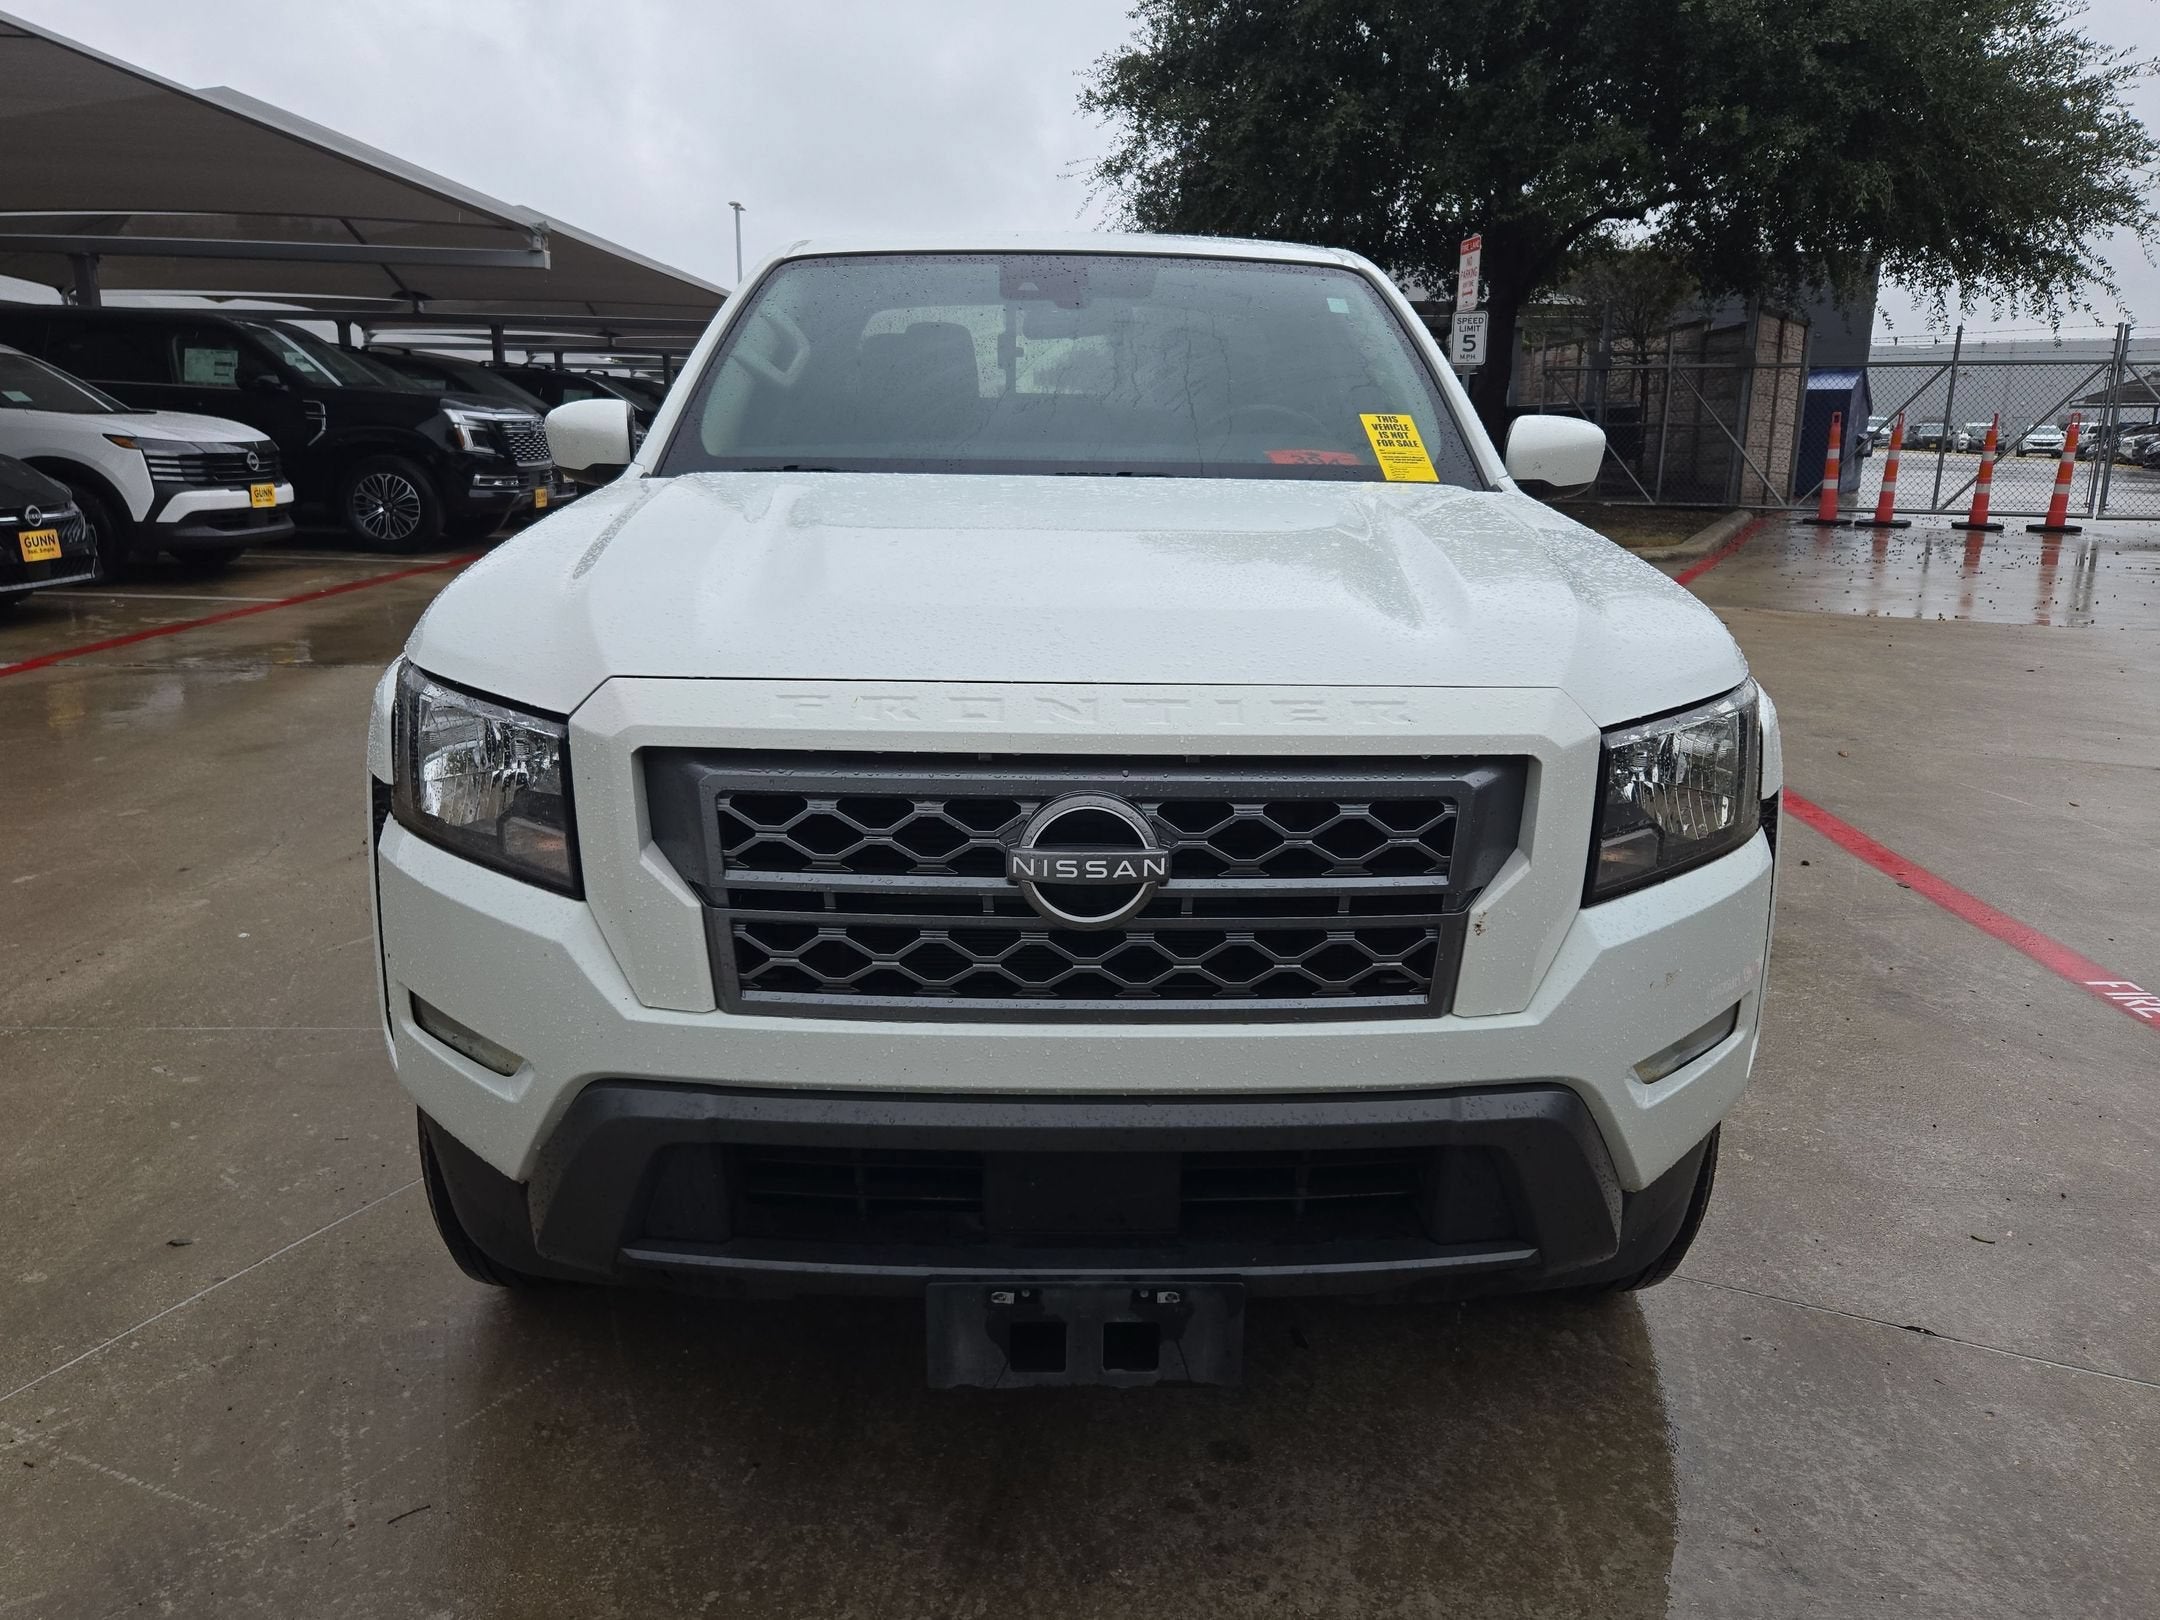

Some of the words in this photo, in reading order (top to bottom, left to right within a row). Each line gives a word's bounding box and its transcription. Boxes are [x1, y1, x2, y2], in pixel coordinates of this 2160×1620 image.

[1456, 317, 1484, 325] SPEED
[1459, 325, 1480, 333] LIMIT
[1462, 334, 1476, 353] 5
[1376, 415, 1398, 423] THIS
[1371, 423, 1410, 432] VEHICLE
[1378, 431, 1389, 439] IS
[1391, 431, 1409, 439] NOT
[1376, 439, 1395, 447] FOR
[1397, 439, 1419, 448] SALE
[253, 487, 273, 498] GUNN
[24, 534, 56, 548] GUNN
[774, 694, 1412, 726] FRONTIER
[1012, 856, 1165, 879] NISSAN
[2083, 981, 2160, 1019] FIRE
